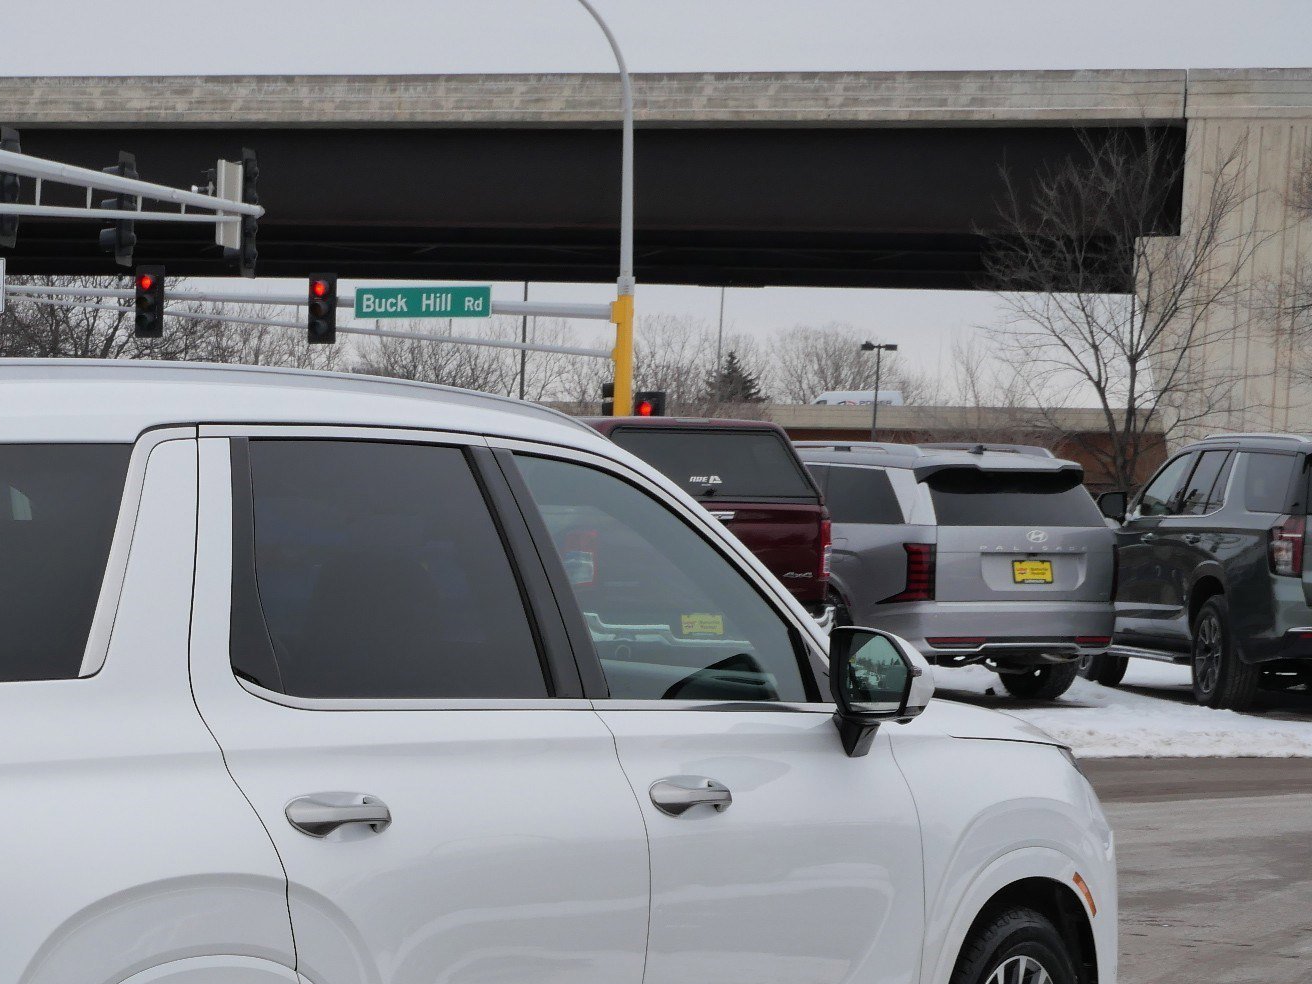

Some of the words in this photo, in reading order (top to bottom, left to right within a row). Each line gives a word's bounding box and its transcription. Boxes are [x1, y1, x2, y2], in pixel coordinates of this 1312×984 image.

[362, 293, 408, 313] Buck
[421, 293, 452, 313] Hill
[464, 296, 484, 311] Rd
